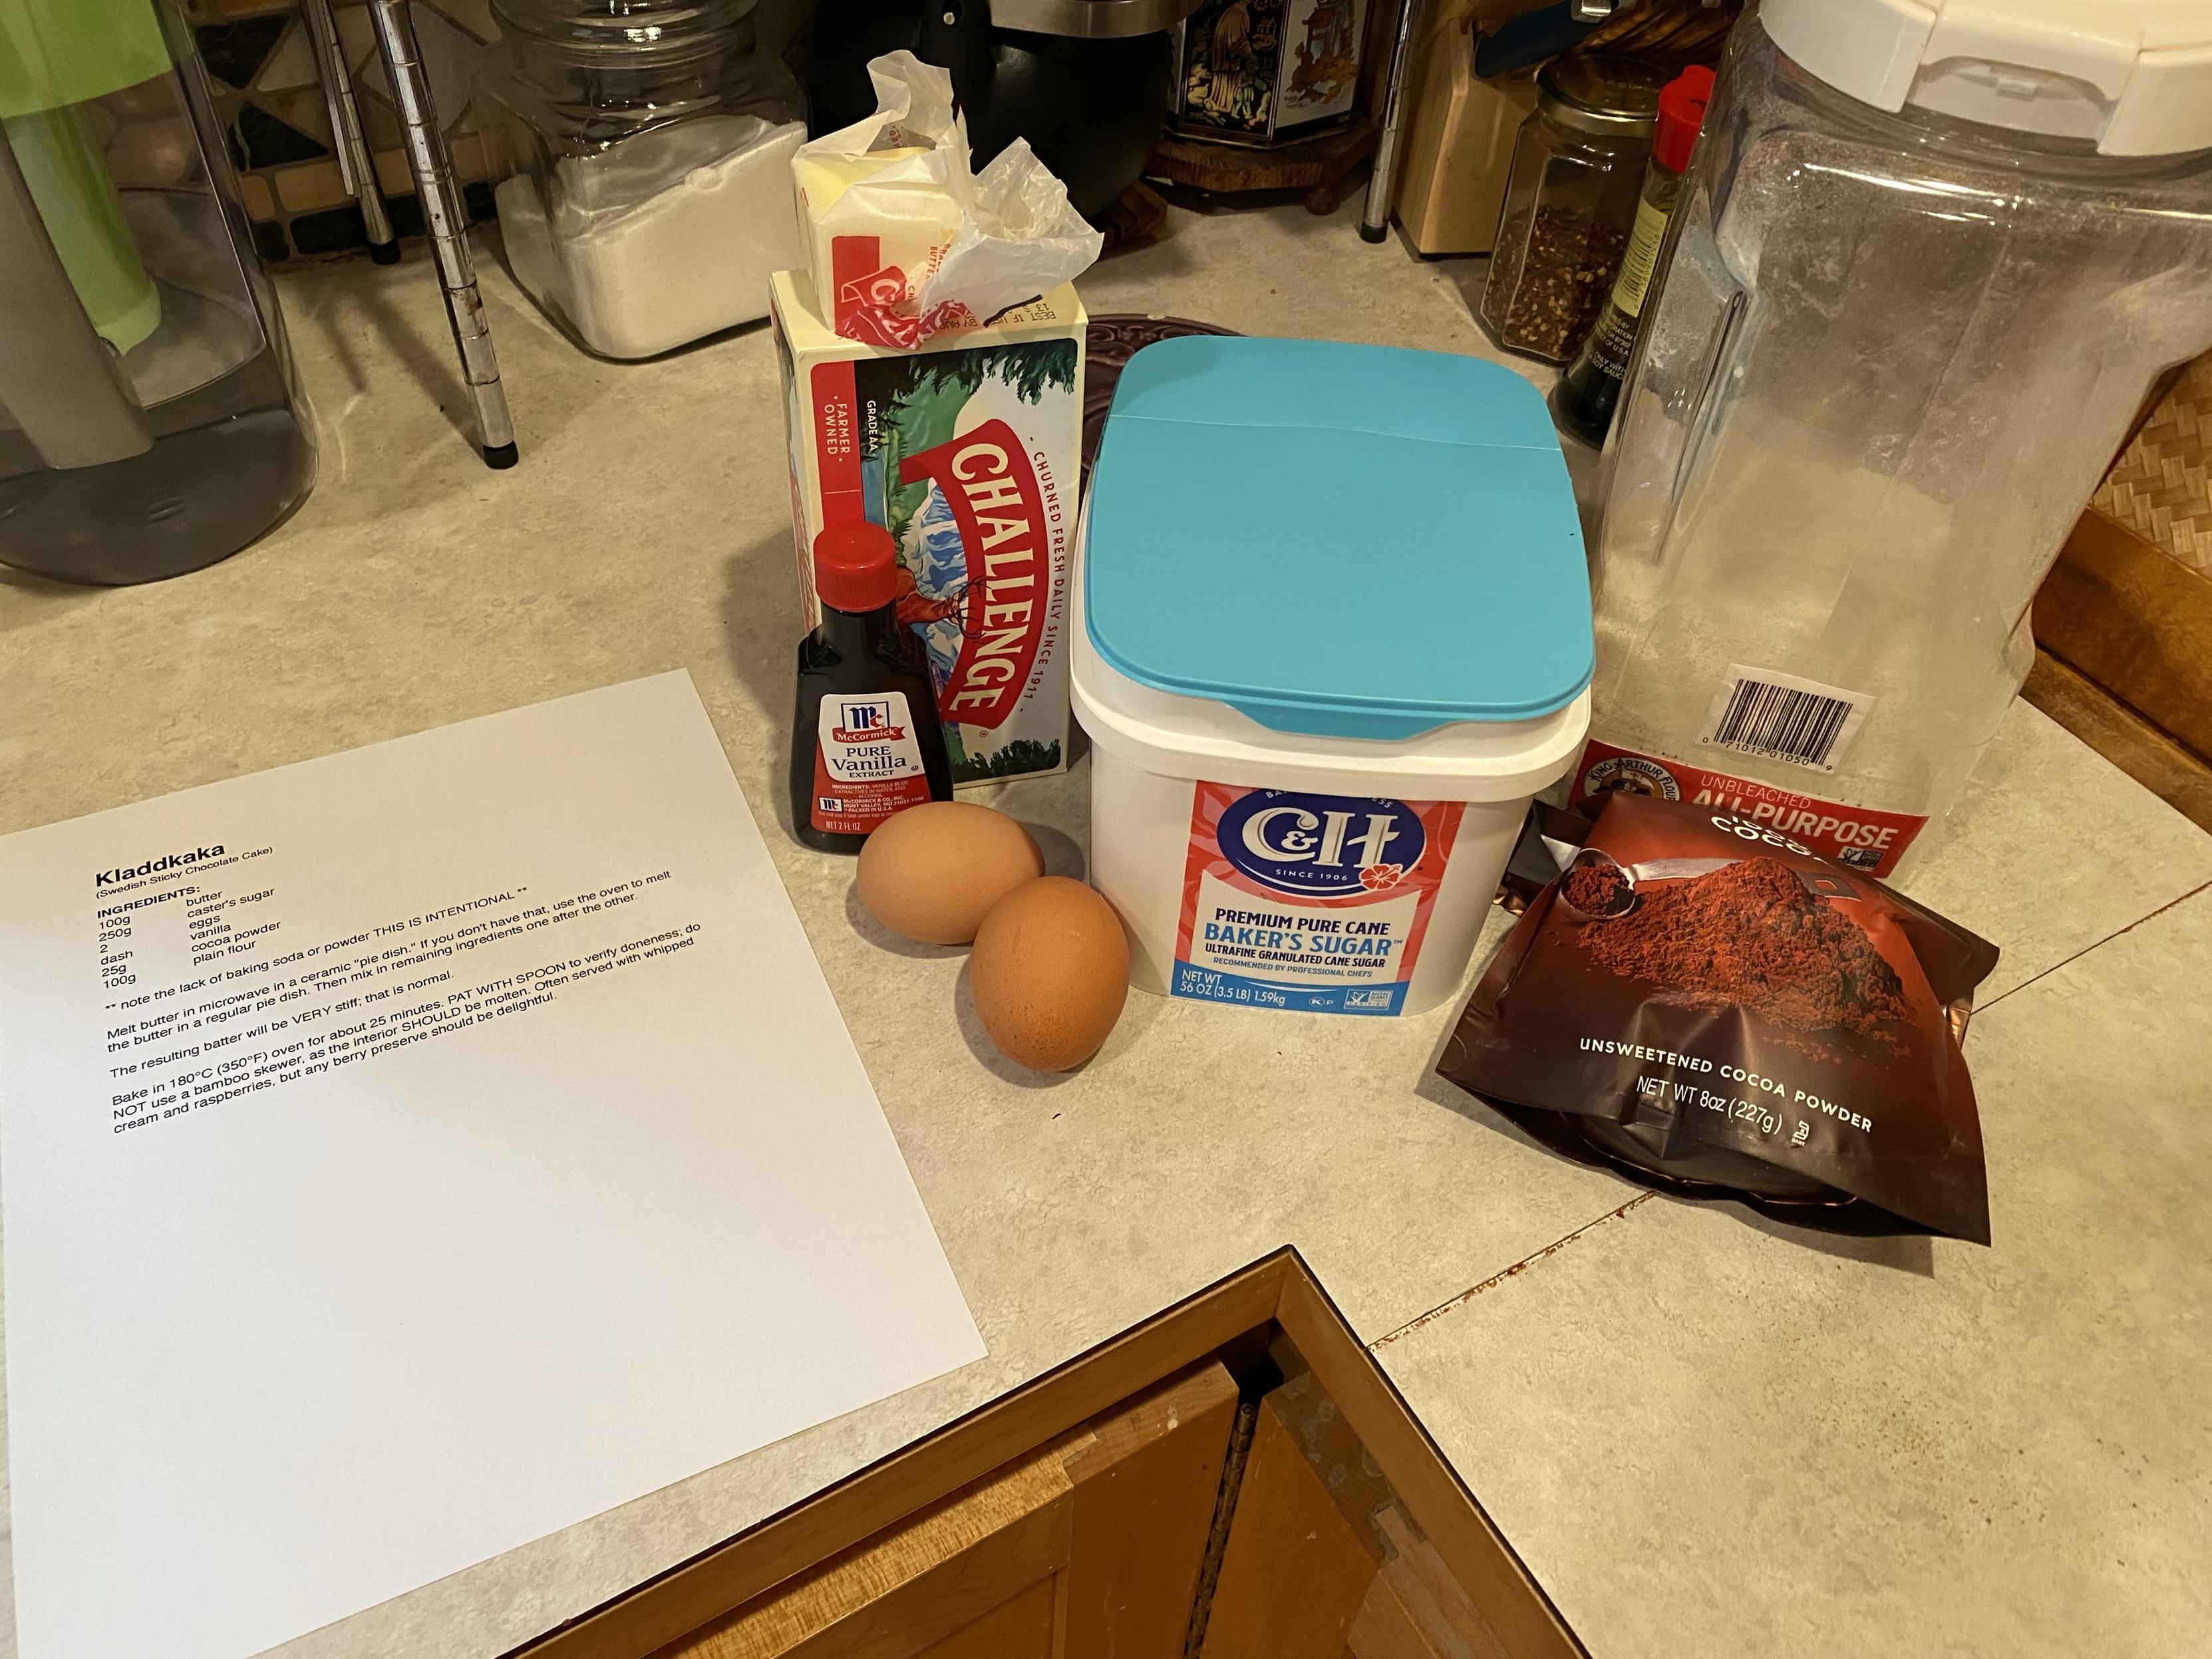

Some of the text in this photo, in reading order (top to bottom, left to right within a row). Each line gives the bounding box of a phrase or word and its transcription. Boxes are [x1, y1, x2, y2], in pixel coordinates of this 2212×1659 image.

[1013, 314, 1025, 323] IF
[1031, 311, 1056, 321] BEST
[1603, 366, 1624, 380] SAUC
[824, 404, 838, 455] OWNED
[836, 403, 851, 454] FARMER
[867, 400, 878, 436] GRADE
[949, 443, 1035, 712] CHALLENGE
[1023, 451, 1065, 699] CHURNED FRESH DAILY SINCE 1911
[836, 728, 896, 742] McCormick
[846, 746, 891, 757] PURE
[831, 756, 907, 771] Vanilla
[1587, 762, 1613, 782] KING
[1613, 757, 1663, 779] ARTHUR
[1725, 741, 1766, 756] 71012
[1769, 750, 1810, 766] 01050
[849, 770, 895, 778] EXTRACT
[1700, 774, 1812, 810] UNBLEACHED
[826, 820, 838, 830] NET
[852, 822, 862, 831] OZ
[1241, 806, 1400, 869] C&H
[96, 845, 225, 887] Kladdkaka
[96, 846, 273, 899] (Swedish Sticky Chocolate Cake)
[1275, 869, 1348, 881] SINCE 1906
[97, 886, 200, 919] INGREDIENTS:
[98, 888, 275, 943] 250g caster's sugar
[99, 891, 223, 930] 100g butter
[100, 915, 221, 954] 2 eggs
[1204, 923, 1303, 951] BAKER'S
[1215, 907, 1390, 935] PREMIUM PURE CANE
[100, 924, 232, 965] dash vanilla
[101, 921, 281, 978] 25g cocoa powder
[107, 871, 671, 1040] Melt butter in microwave in a ceramic "pie dish." If you don't have that, use the oven to melt
[121, 891, 516, 1010] note the lack of baking soda or powder THIS IS INTENTIONAL
[1205, 943, 1386, 968] ULTRAFINE GRANULATED CANE SUGAR
[103, 941, 256, 989] 100g plain flour
[1182, 969, 1223, 985] NET WT
[1213, 957, 1273, 971] RECOMMENDED
[1287, 966, 1345, 977] PROFESSIONAL
[1180, 981, 1286, 1007] 56 OZ (3.5 LB) 1.59kg
[109, 970, 454, 1078] The resulting batter will be VERY stiff; that is normal.
[112, 924, 701, 1106] Bake in 180°C (350°F) oven for about 25 minutes. PAT WITH SPOON to verify doneness; do
[1579, 1038, 1873, 1133] UNSWEETENED COCOA POWDER
[1636, 1075, 1670, 1098] NET
[1674, 1083, 1698, 1104] WT
[1728, 1098, 1783, 1135] (227g)
